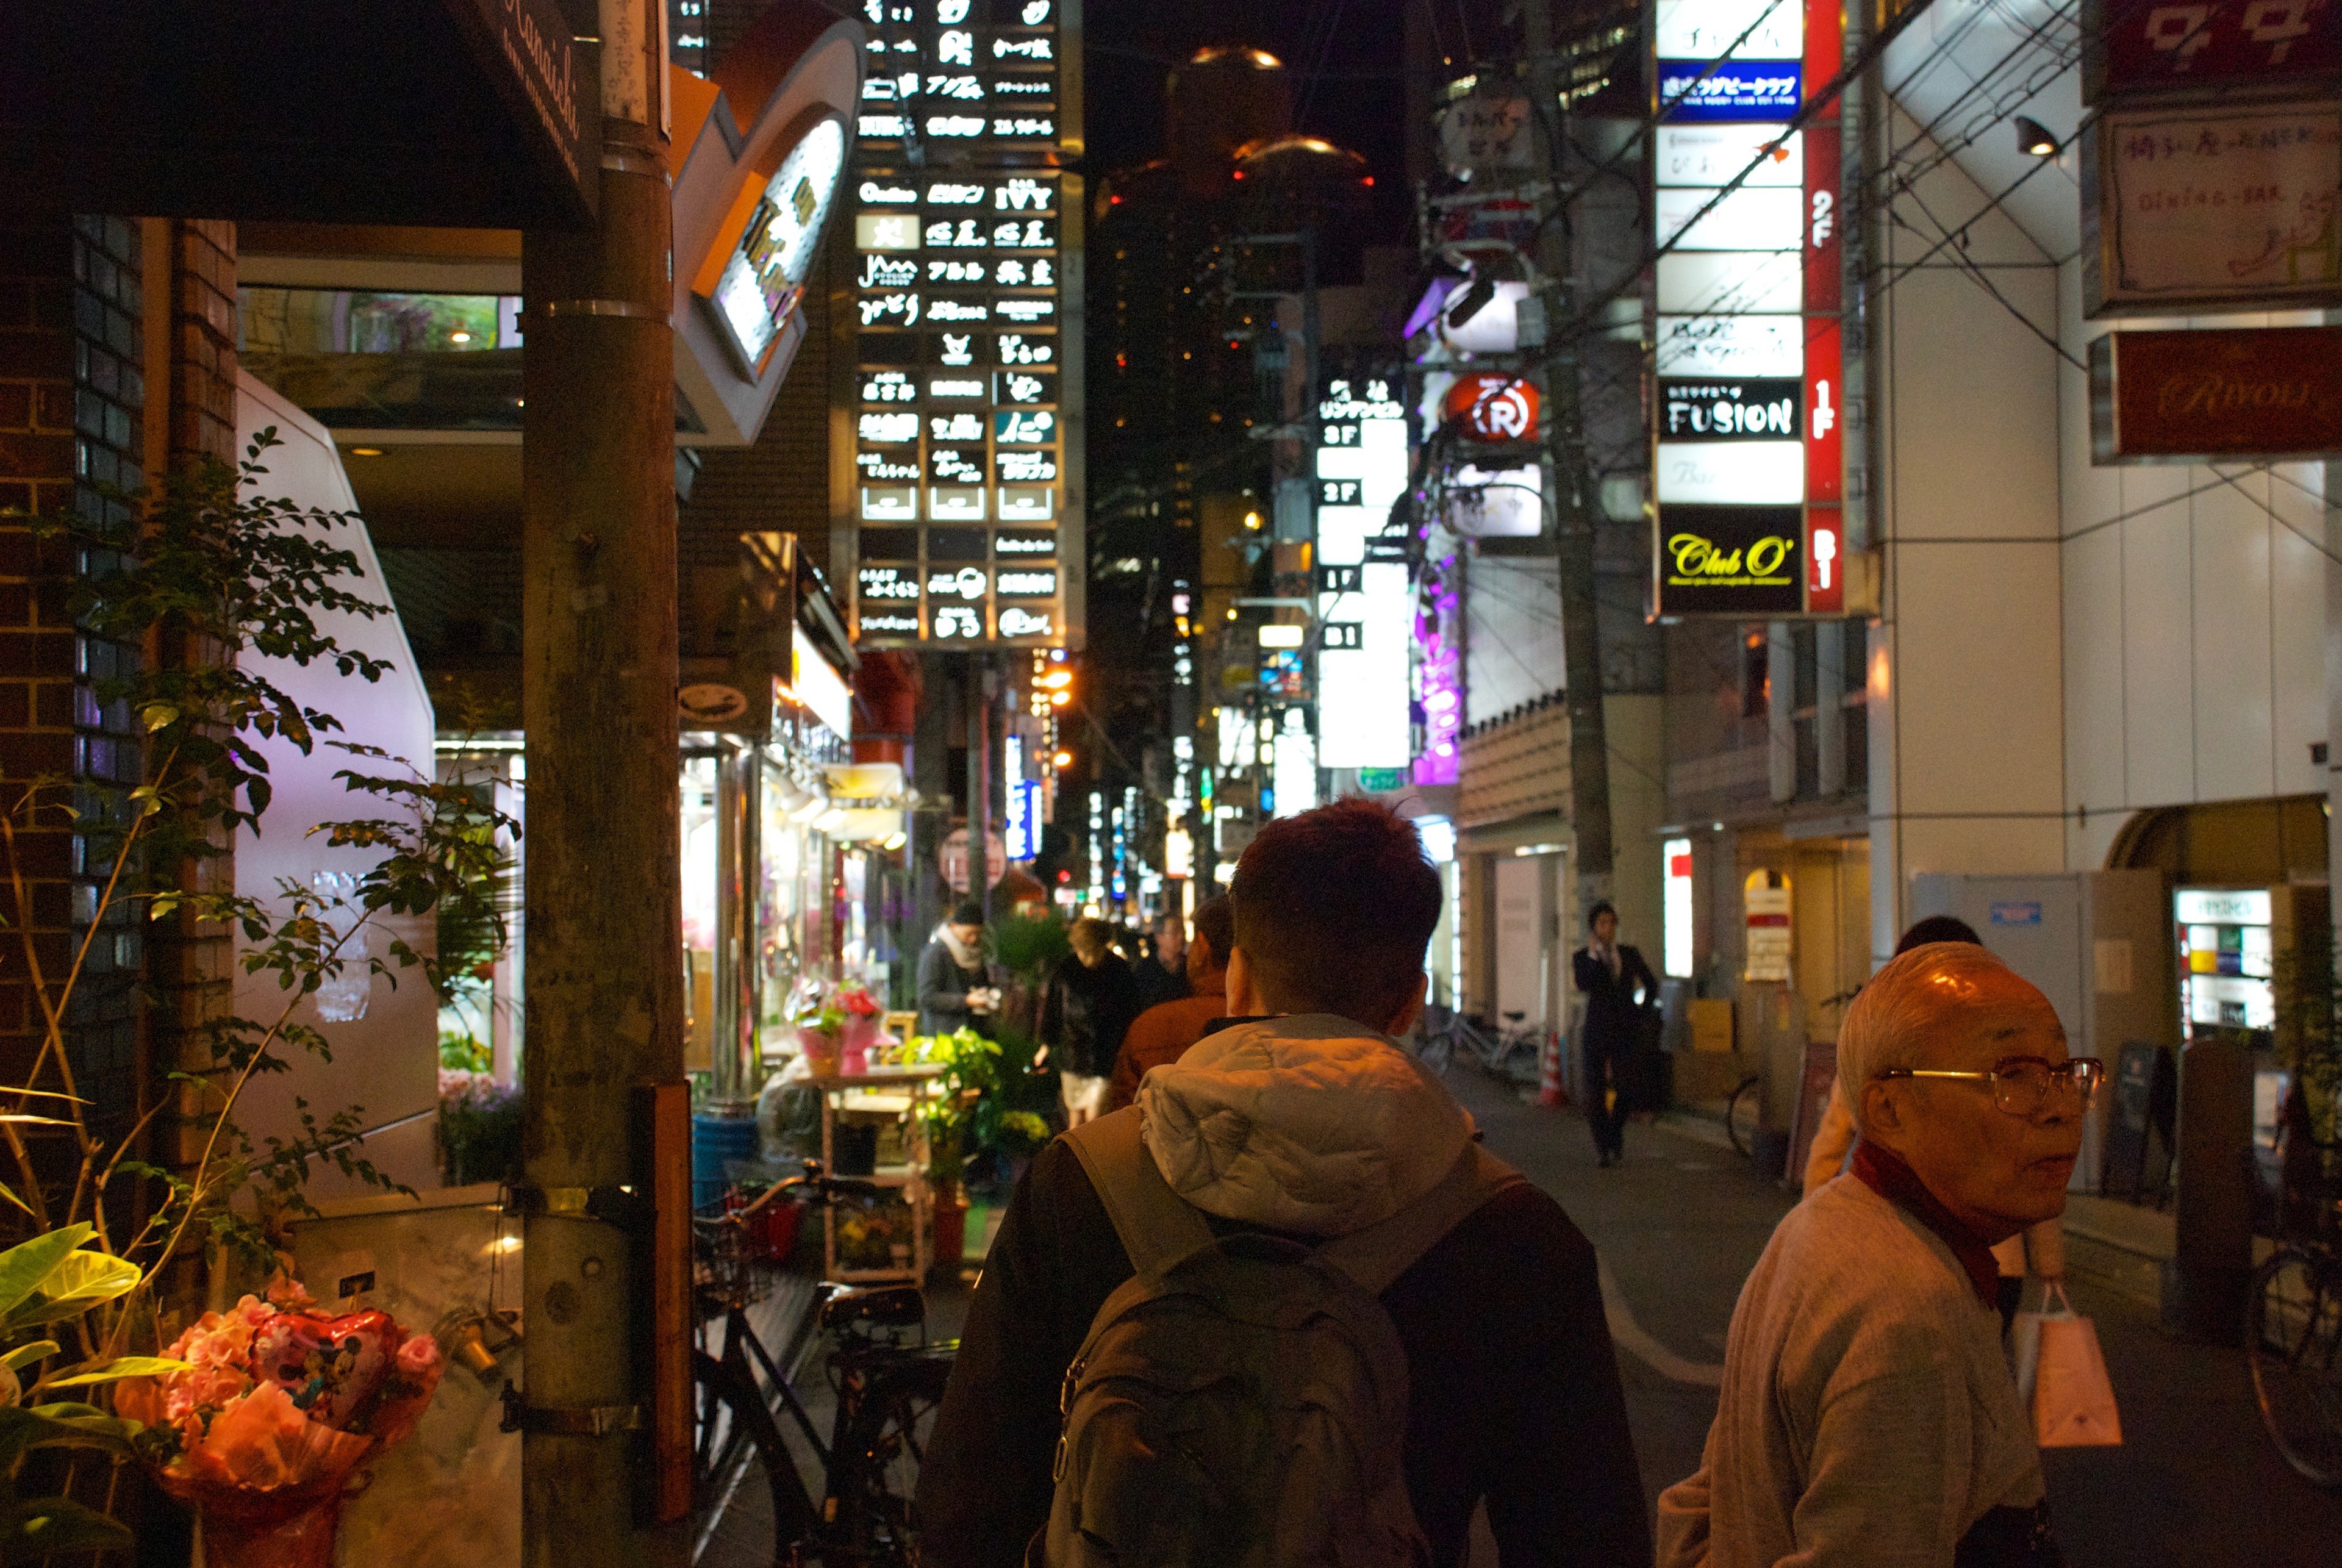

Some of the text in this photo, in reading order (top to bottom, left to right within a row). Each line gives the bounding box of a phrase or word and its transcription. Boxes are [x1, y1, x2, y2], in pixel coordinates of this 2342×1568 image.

[995, 187, 1053, 210] IVY
[1811, 190, 1833, 248] 2F
[1667, 398, 1792, 434] FUSION
[1813, 379, 1835, 439] 1F
[1323, 482, 1357, 502] 2F
[1667, 532, 1742, 576] Club
[1813, 529, 1836, 589] B1
[1325, 625, 1356, 646] B1
